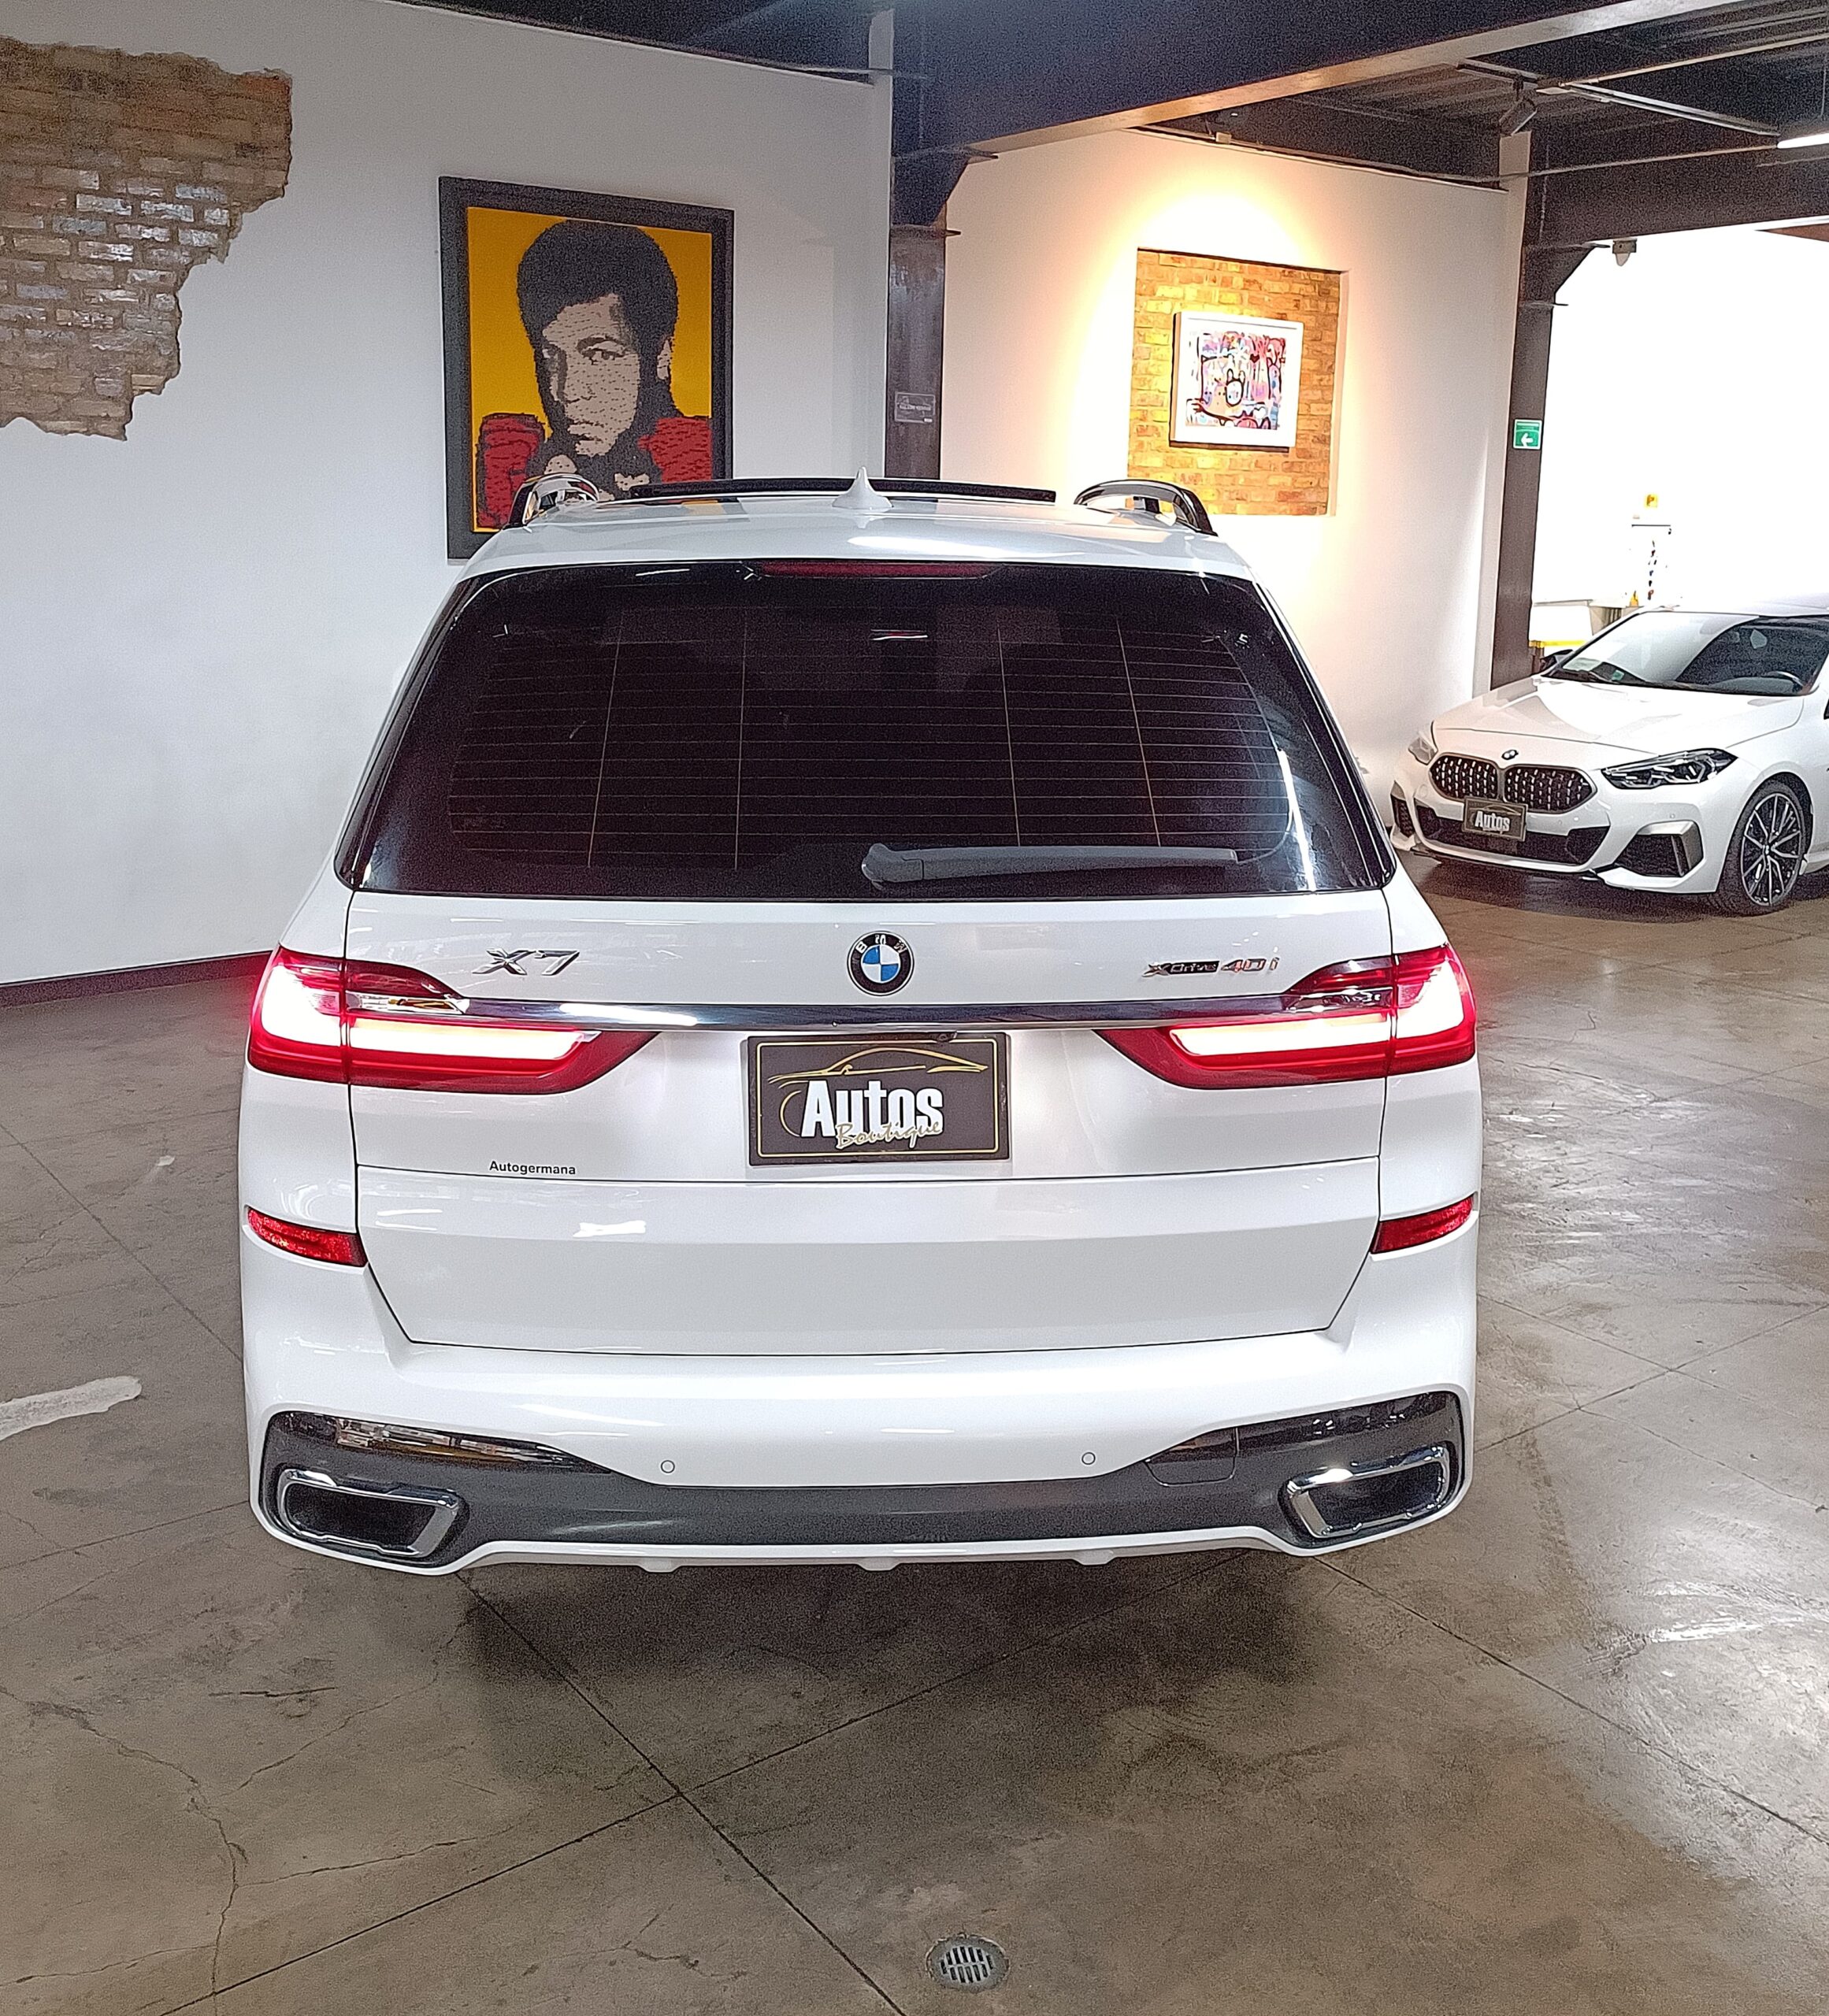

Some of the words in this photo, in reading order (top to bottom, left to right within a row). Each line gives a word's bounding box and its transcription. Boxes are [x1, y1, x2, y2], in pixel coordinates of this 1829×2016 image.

[1475, 810, 1510, 832] Autos
[472, 948, 580, 976] X7
[801, 1080, 944, 1137] Autos
[836, 1121, 941, 1148] Boutique
[489, 1160, 576, 1175] Autogermana
